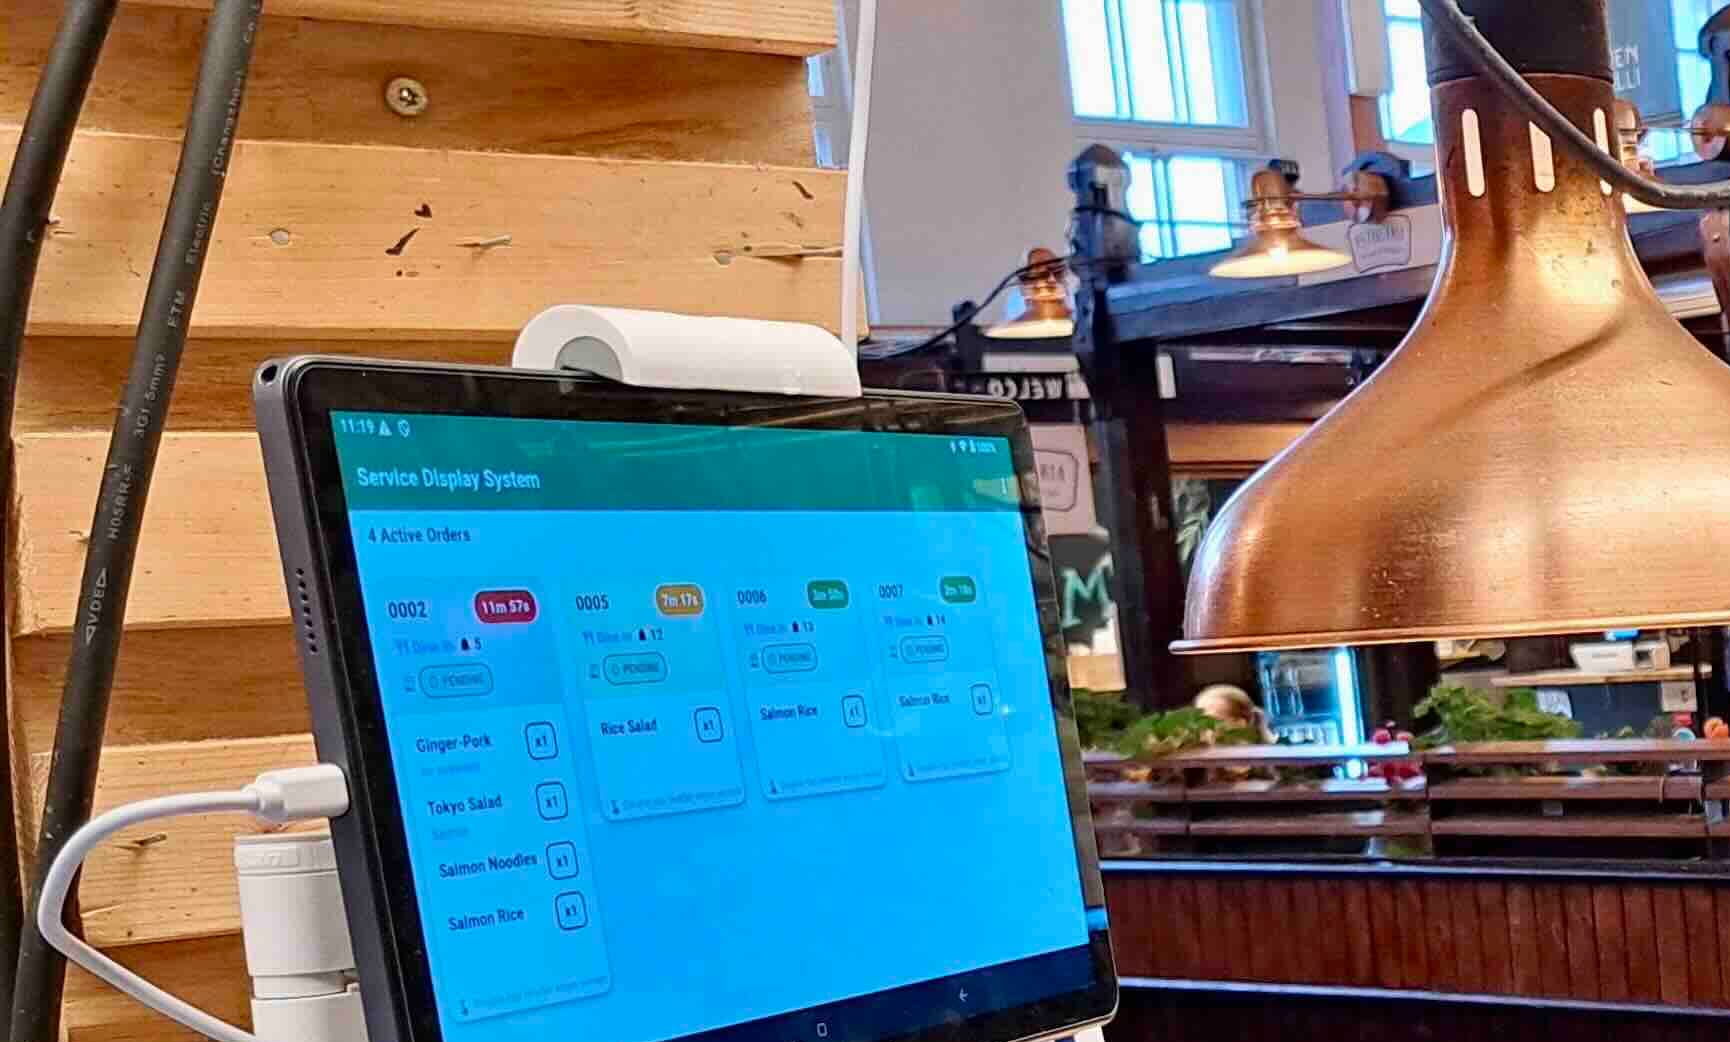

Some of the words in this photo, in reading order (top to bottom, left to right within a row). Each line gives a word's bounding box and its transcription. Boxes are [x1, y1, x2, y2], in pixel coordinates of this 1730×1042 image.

[357, 467, 418, 488] Service
[422, 468, 480, 493] Display
[483, 469, 541, 493] System
[368, 529, 377, 543] 4
[381, 529, 423, 543] Active
[427, 527, 471, 543] Orders
[388, 601, 428, 618] 0002
[575, 595, 609, 611] 0005
[760, 704, 797, 721] Salmon
[798, 703, 818, 718] Rice
[600, 721, 625, 736] Rice
[627, 717, 657, 734] Salad
[416, 733, 491, 754] Ginger-Pork
[427, 799, 465, 816] Tokyo
[467, 795, 503, 812] Salad
[439, 861, 486, 879] Salmon
[488, 852, 538, 872] Noodles
[448, 913, 495, 932] Salmon
[498, 907, 525, 926] Rice
